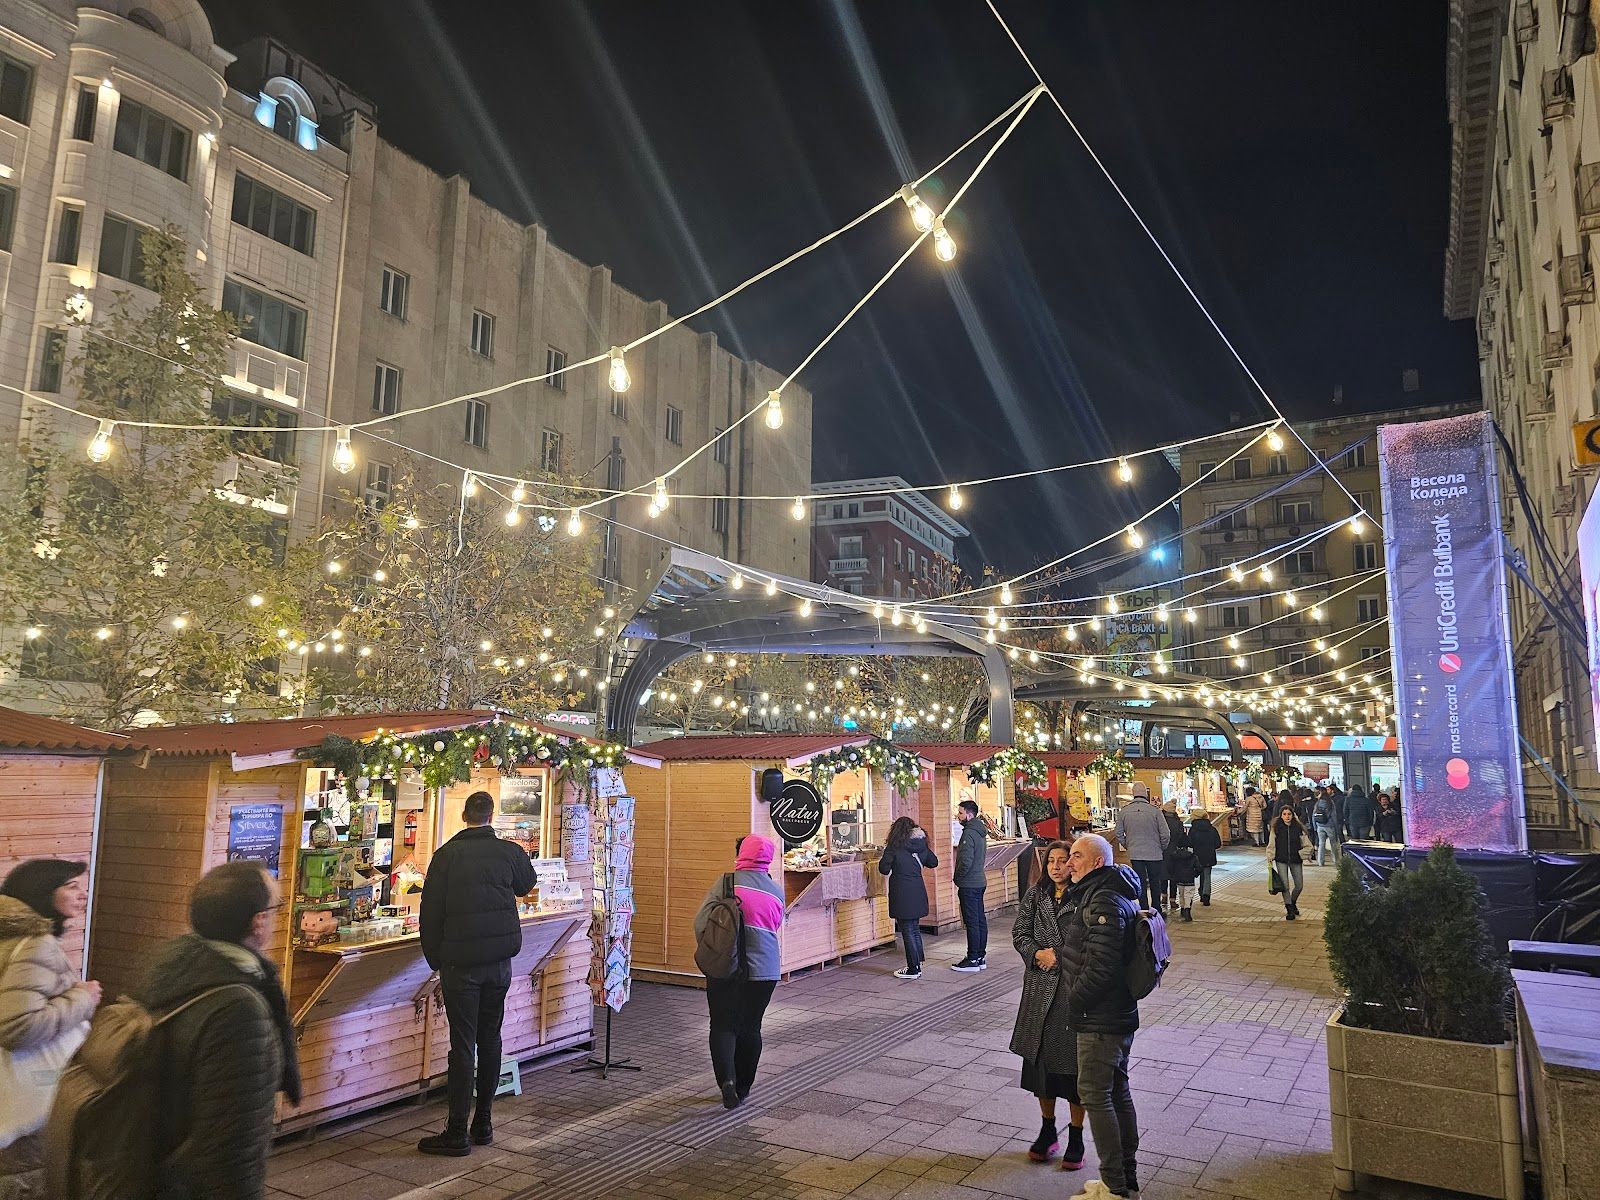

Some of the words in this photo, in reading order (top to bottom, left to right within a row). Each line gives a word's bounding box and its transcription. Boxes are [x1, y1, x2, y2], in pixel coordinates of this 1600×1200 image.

[1410, 485, 1468, 500] Коледа
[1411, 474, 1466, 488] Весела
[1431, 513, 1454, 577] Bulbank
[1436, 580, 1460, 652] UniCredit
[1444, 684, 1461, 754] mastercard
[771, 797, 819, 820] Natur
